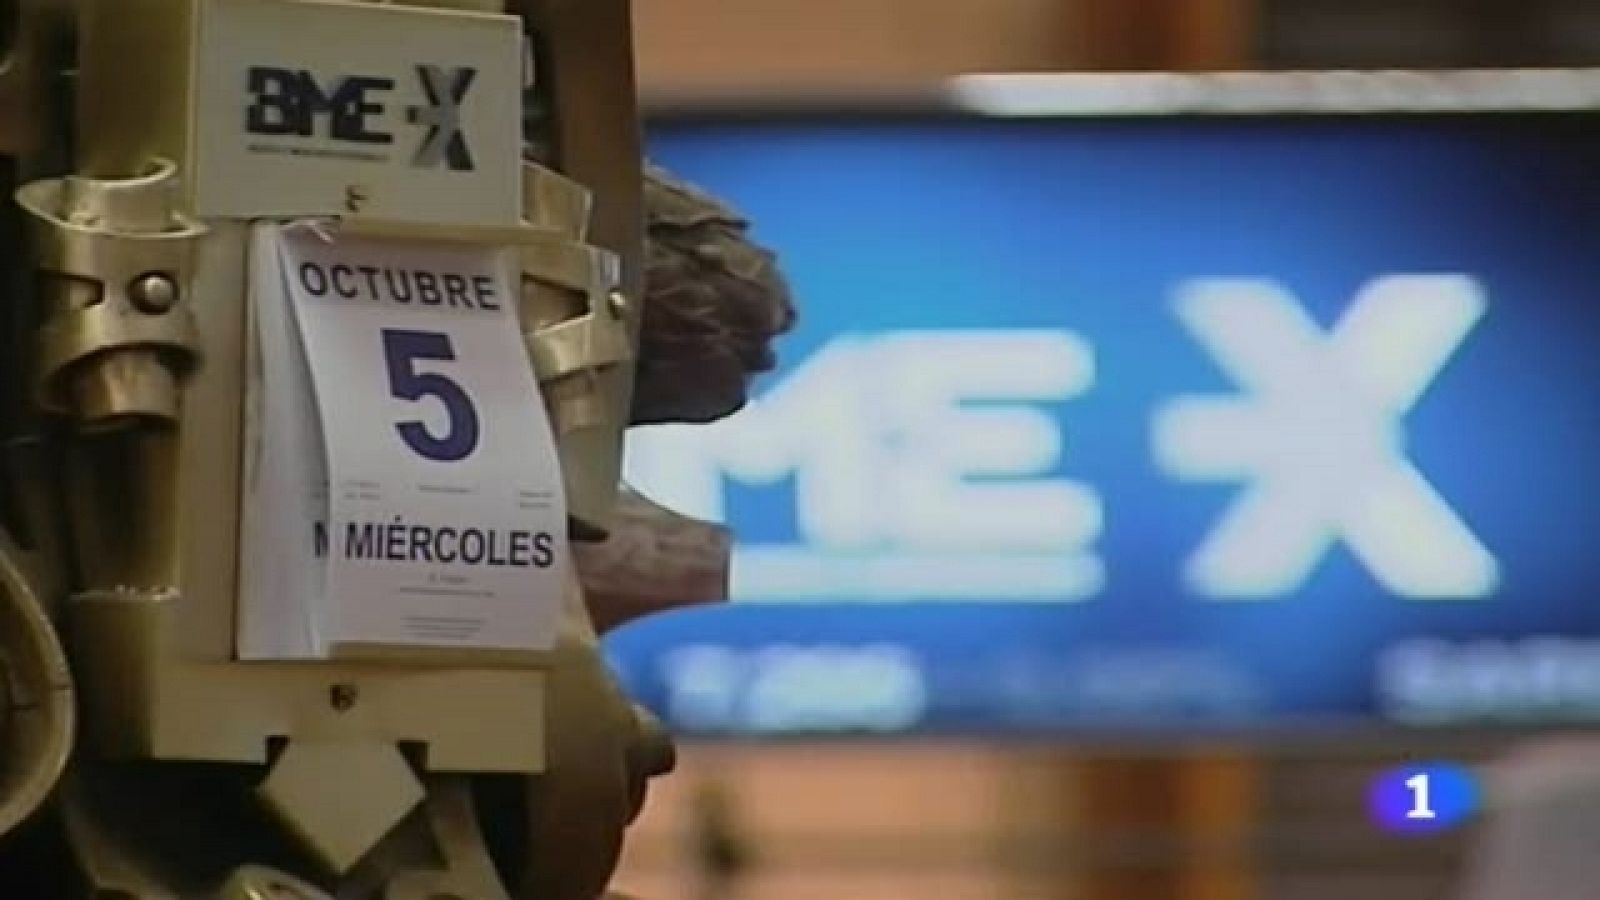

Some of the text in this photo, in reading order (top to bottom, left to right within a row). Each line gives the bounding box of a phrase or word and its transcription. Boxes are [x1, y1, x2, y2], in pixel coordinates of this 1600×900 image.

[246, 65, 396, 143] BME
[299, 261, 501, 312] OCTUBRE
[381, 327, 479, 462] 5
[344, 515, 555, 569] MIÉRCOLES
